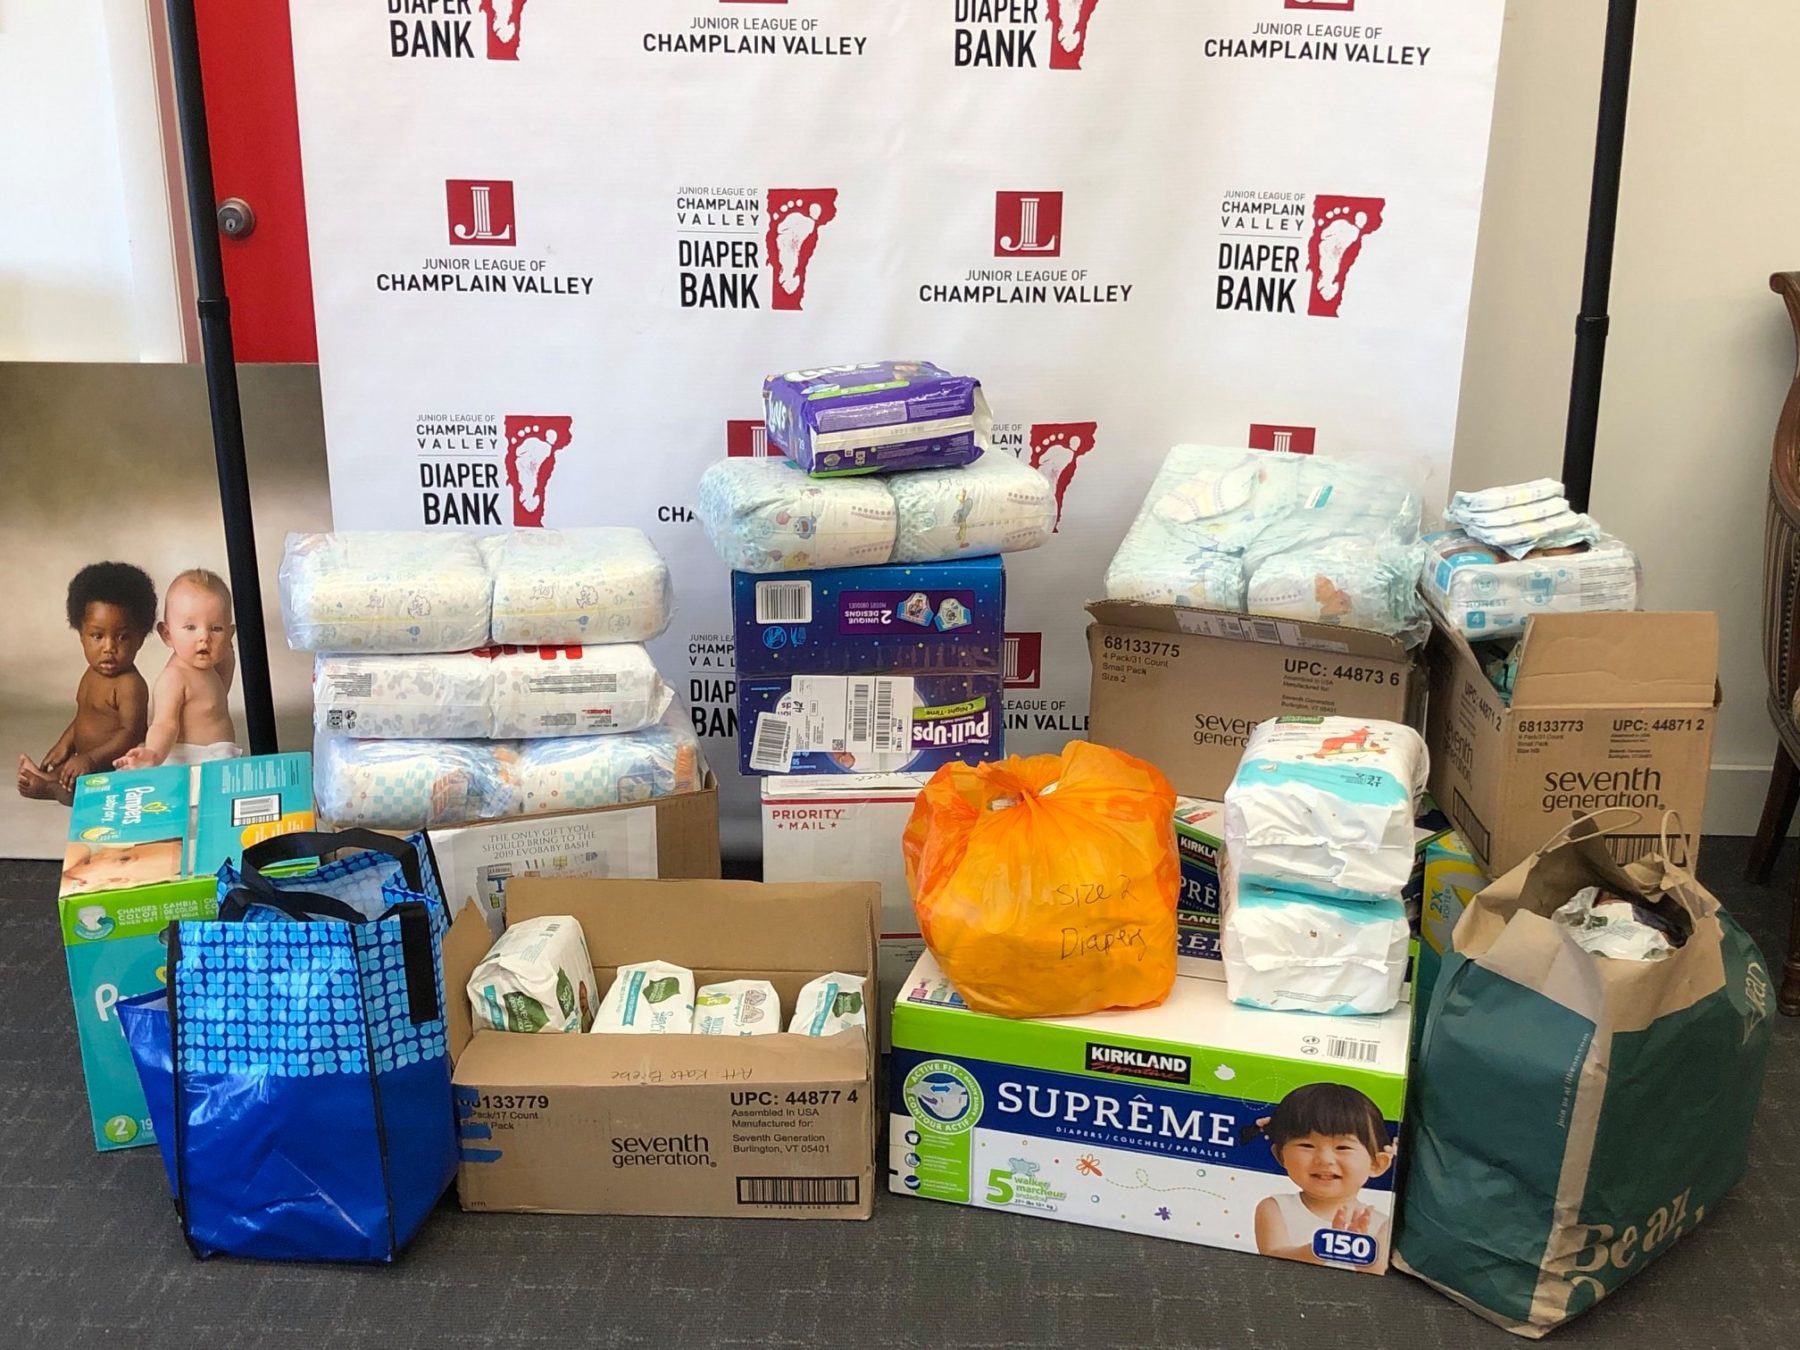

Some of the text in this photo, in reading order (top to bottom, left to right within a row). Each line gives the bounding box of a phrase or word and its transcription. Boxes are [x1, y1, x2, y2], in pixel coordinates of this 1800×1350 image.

[955, 0, 1038, 23] DIAPER
[690, 16, 818, 31] JUNIOR LEAGUE OF
[1252, 22, 1382, 39] JUNIOR LEAGUE OF
[389, 20, 475, 58] BANK
[643, 34, 867, 56] CHAMPLAIN VALLEY
[955, 29, 1037, 67] BANK
[1204, 39, 1431, 66] CHAMPLAIN VALLEY
[677, 187, 758, 197] JUNIOR LEAGUE OF
[1224, 190, 1306, 201] JUNIOR LEAGUE OF
[676, 198, 759, 212] CHAMPLAIN
[1222, 201, 1305, 216] CHAMPLAIN
[677, 213, 760, 228] VALLEY
[1221, 216, 1304, 231] VALLEY
[679, 240, 759, 269] DIAPER
[1218, 243, 1299, 273] DIAPER
[422, 258, 547, 272] JUNIOR LEAGUE OF
[376, 274, 594, 295] CHAMPLAIN VALLEY
[965, 269, 1088, 282] JUNIOR LEAGUE OF
[680, 273, 760, 309] BANK
[919, 284, 1133, 303] CHAMPLAIN VALLEY
[1216, 276, 1297, 314] BANK
[416, 414, 496, 422] JUNIOR LEAGUE OF
[416, 424, 498, 436] CHAMPLAIN
[417, 438, 498, 450] VALLEY
[420, 463, 500, 489] DIAPER
[423, 492, 503, 526] BANK
[845, 609, 892, 623] 2 DESIGNS
[689, 643, 735, 654] CHAMP
[1104, 635, 1181, 658] 68133775
[689, 656, 736, 667] VALL
[1102, 662, 1146, 676] Small Pack
[1110, 652, 1142, 664] Pack/31
[1144, 657, 1168, 668] Count
[1102, 672, 1127, 683] Size 2
[1284, 658, 1400, 686] UPC: 44873 6
[690, 679, 736, 703] DIAP
[1051, 700, 1066, 711] OF
[691, 706, 739, 737] BAN
[1034, 714, 1089, 731] VALLE
[1195, 713, 1257, 735] seven
[1518, 720, 1584, 732] 68133773
[1612, 719, 1705, 732] UPC: 44871 2
[1193, 729, 1248, 749] genera
[1544, 767, 1661, 792] seventh
[122, 786, 155, 824] Pampers
[1542, 792, 1659, 813] generation
[773, 809, 843, 819] PRIORITY
[489, 823, 590, 842] THE ONLY GIFT YOU
[789, 822, 826, 830] MAIL
[482, 830, 597, 853] SHOULD BRING TO THE
[494, 840, 590, 860] 2019 EVOBABY BASH
[1180, 836, 1217, 857] KIRKLA
[1120, 874, 1139, 901] 2
[117, 905, 158, 915] CHANGES
[163, 900, 198, 909] CAMBIA
[1431, 890, 1444, 914] 2X
[118, 911, 158, 921] COLOR
[1178, 913, 1221, 925] LAND
[1091, 1046, 1187, 1073] KIRKLAND
[911, 1063, 958, 1083] ACTIVE FIT
[730, 1089, 858, 1106] UPC: 44877 4
[510, 1111, 538, 1119] Count
[731, 1108, 783, 1117] Assembled
[798, 1108, 820, 1117] USA
[908, 1095, 970, 1131] CONTOUR ACTIF
[998, 1081, 1235, 1147] SUPRÊME
[114, 1118, 128, 1137] 2
[491, 1121, 514, 1129] Pack
[732, 1119, 814, 1128] Manufactured for:
[611, 1133, 709, 1154] seventh
[732, 1134, 825, 1142] Seventh Generation
[612, 1149, 711, 1168] generation
[733, 1144, 830, 1154] Burlington, VT 05401
[986, 1168, 1014, 1203] 5
[1320, 1232, 1372, 1260] 150
